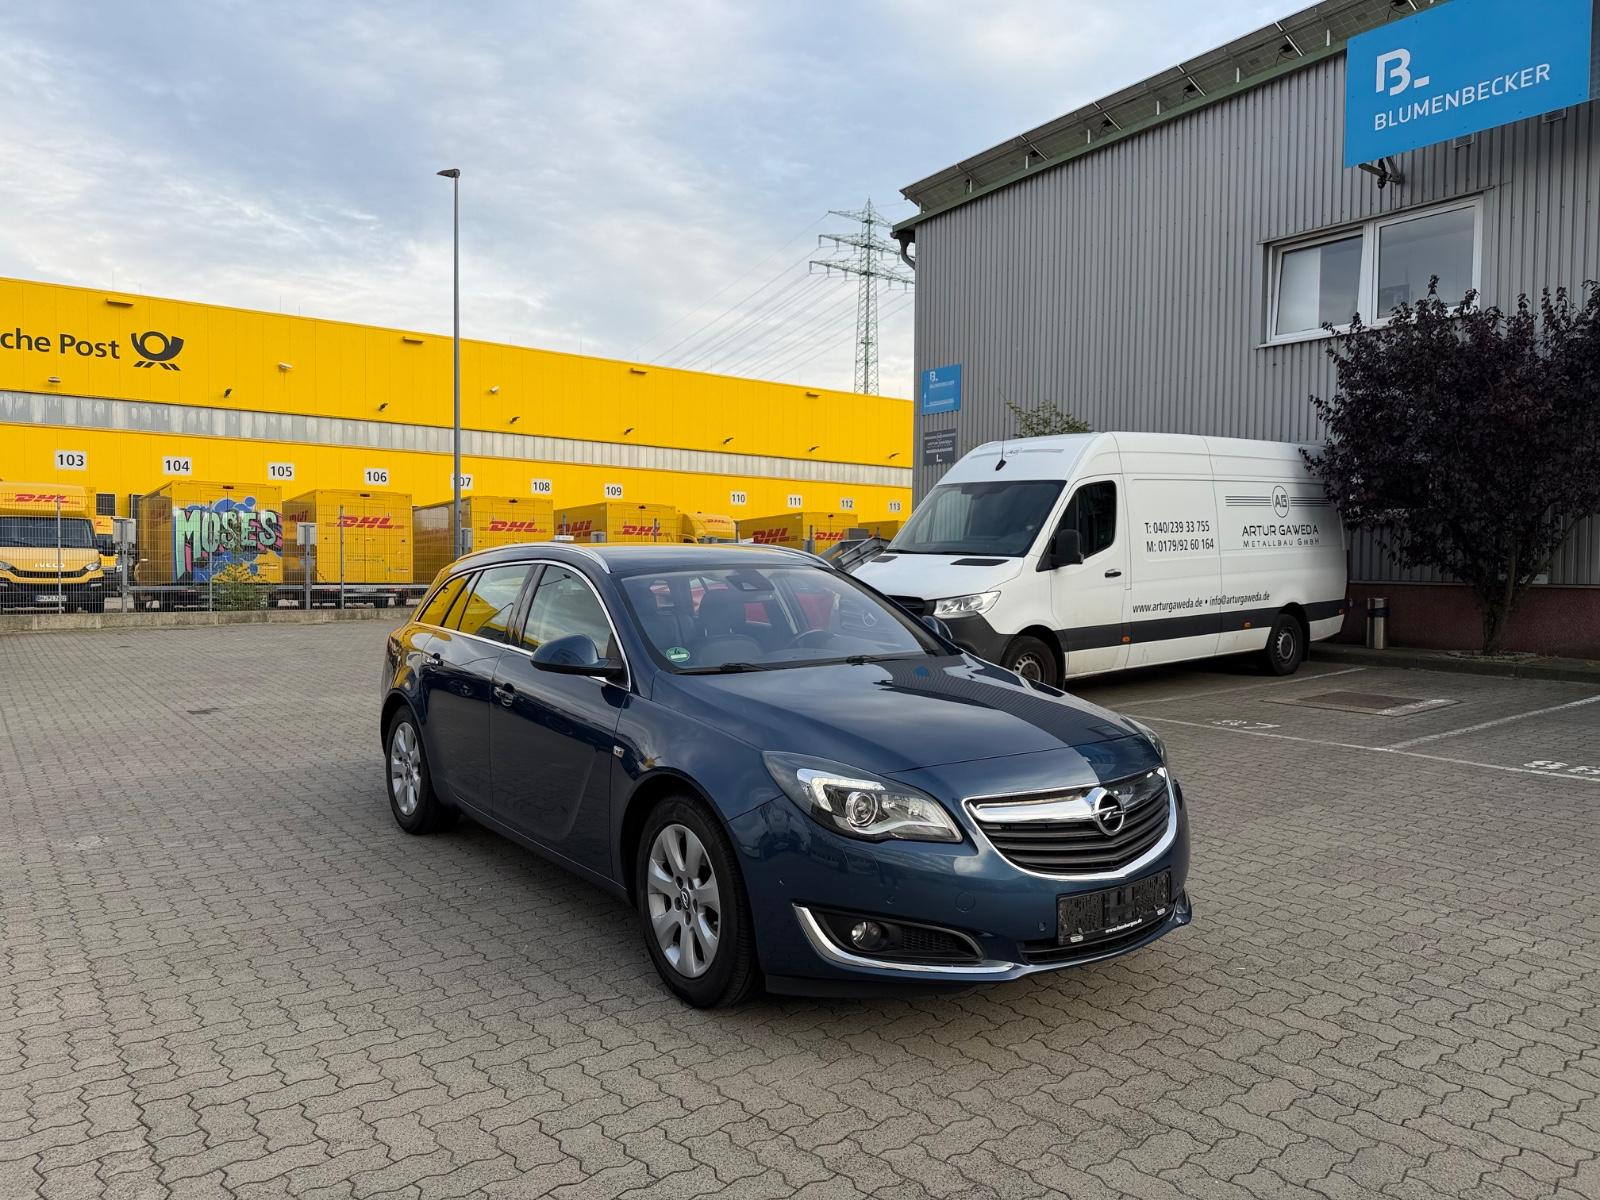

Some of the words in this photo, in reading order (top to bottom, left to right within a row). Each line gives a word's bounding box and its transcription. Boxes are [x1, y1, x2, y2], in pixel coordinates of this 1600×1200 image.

[1374, 63, 1551, 131] BLUMENBECKER
[59, 333, 120, 360] Post
[57, 454, 84, 468] 103
[165, 459, 190, 473] 104
[270, 465, 293, 478] 105
[366, 471, 387, 483] 106
[453, 476, 472, 488] 07
[533, 481, 551, 492] 108
[605, 486, 622, 497] 109
[731, 493, 746, 503] 110
[15, 493, 70, 504] DHL
[789, 497, 801, 506] 111
[841, 500, 853, 509] 112
[889, 502, 901, 511] 113
[338, 516, 394, 529] DHL
[488, 520, 538, 533] DHL
[1144, 522, 1151, 533] T:
[1153, 521, 1183, 534] 040/239
[1185, 521, 1195, 532] 33
[1197, 520, 1210, 532] 755
[622, 525, 663, 537] DHL
[752, 528, 790, 545] DHL
[815, 531, 844, 541] DH
[1242, 525, 1277, 537] ARTUR
[1278, 524, 1319, 536] GAWEDA
[174, 508, 278, 580] MOSES
[1146, 542, 1156, 552] M:
[1158, 539, 1187, 552] 0179/92
[1190, 539, 1199, 550] 60
[1201, 538, 1214, 550] 164
[1132, 597, 1203, 613] www.arturgaweda.de
[1209, 591, 1270, 606] info@arturgaweda.de
